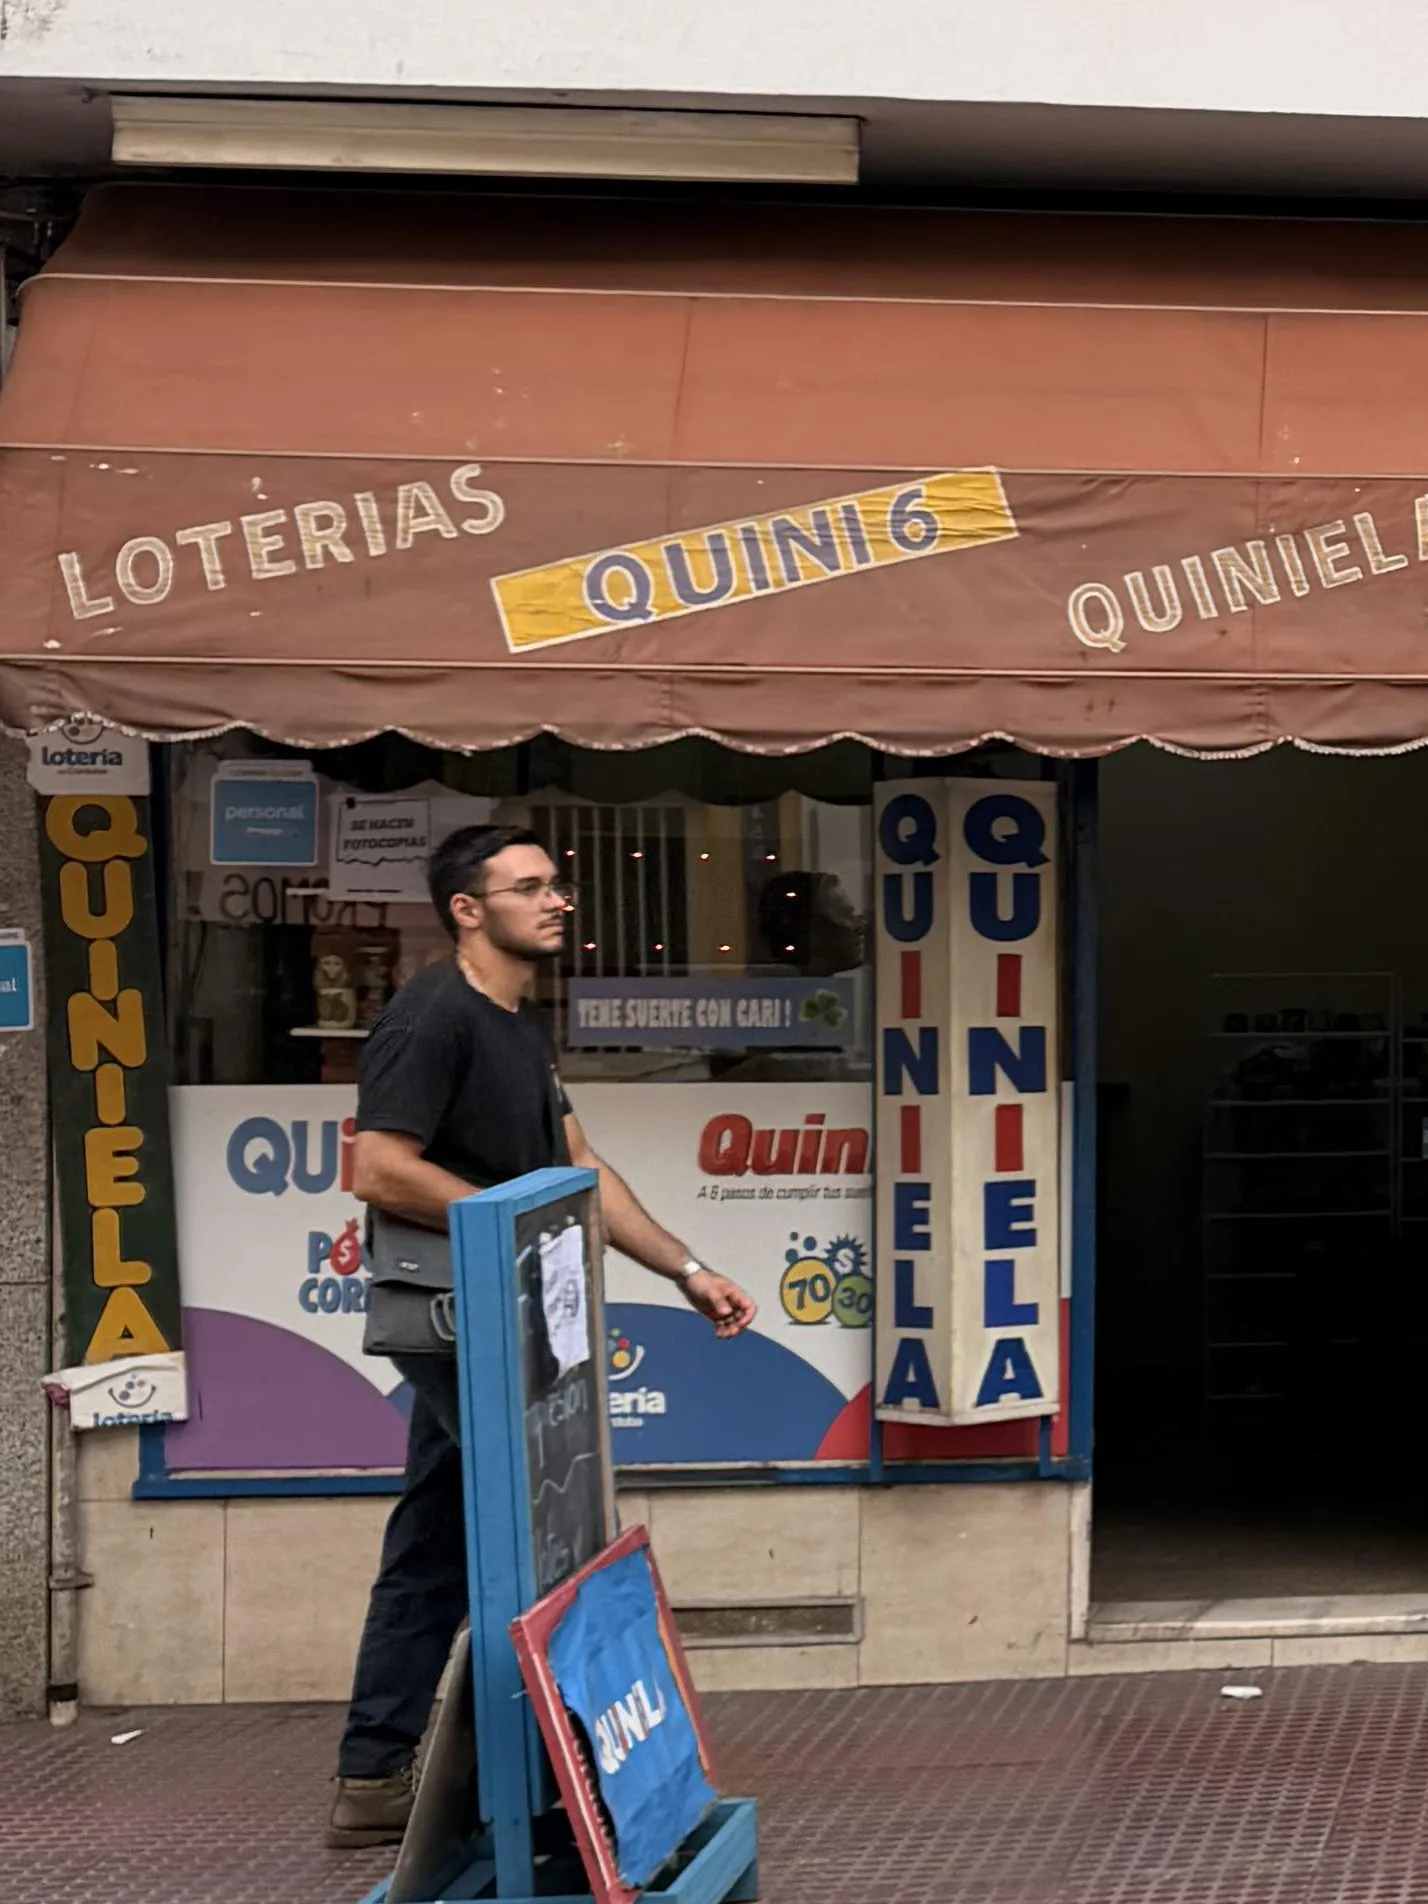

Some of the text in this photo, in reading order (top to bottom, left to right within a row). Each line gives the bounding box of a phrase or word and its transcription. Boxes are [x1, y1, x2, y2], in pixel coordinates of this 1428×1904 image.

[583, 486, 941, 625] QUINI 6
[45, 795, 170, 1365] QUINIELA
[626, 998, 693, 1028] SUERTE
[696, 998, 732, 1028] CON
[878, 793, 942, 1409] QUINIELA
[963, 793, 1051, 1408] QUINIELA
